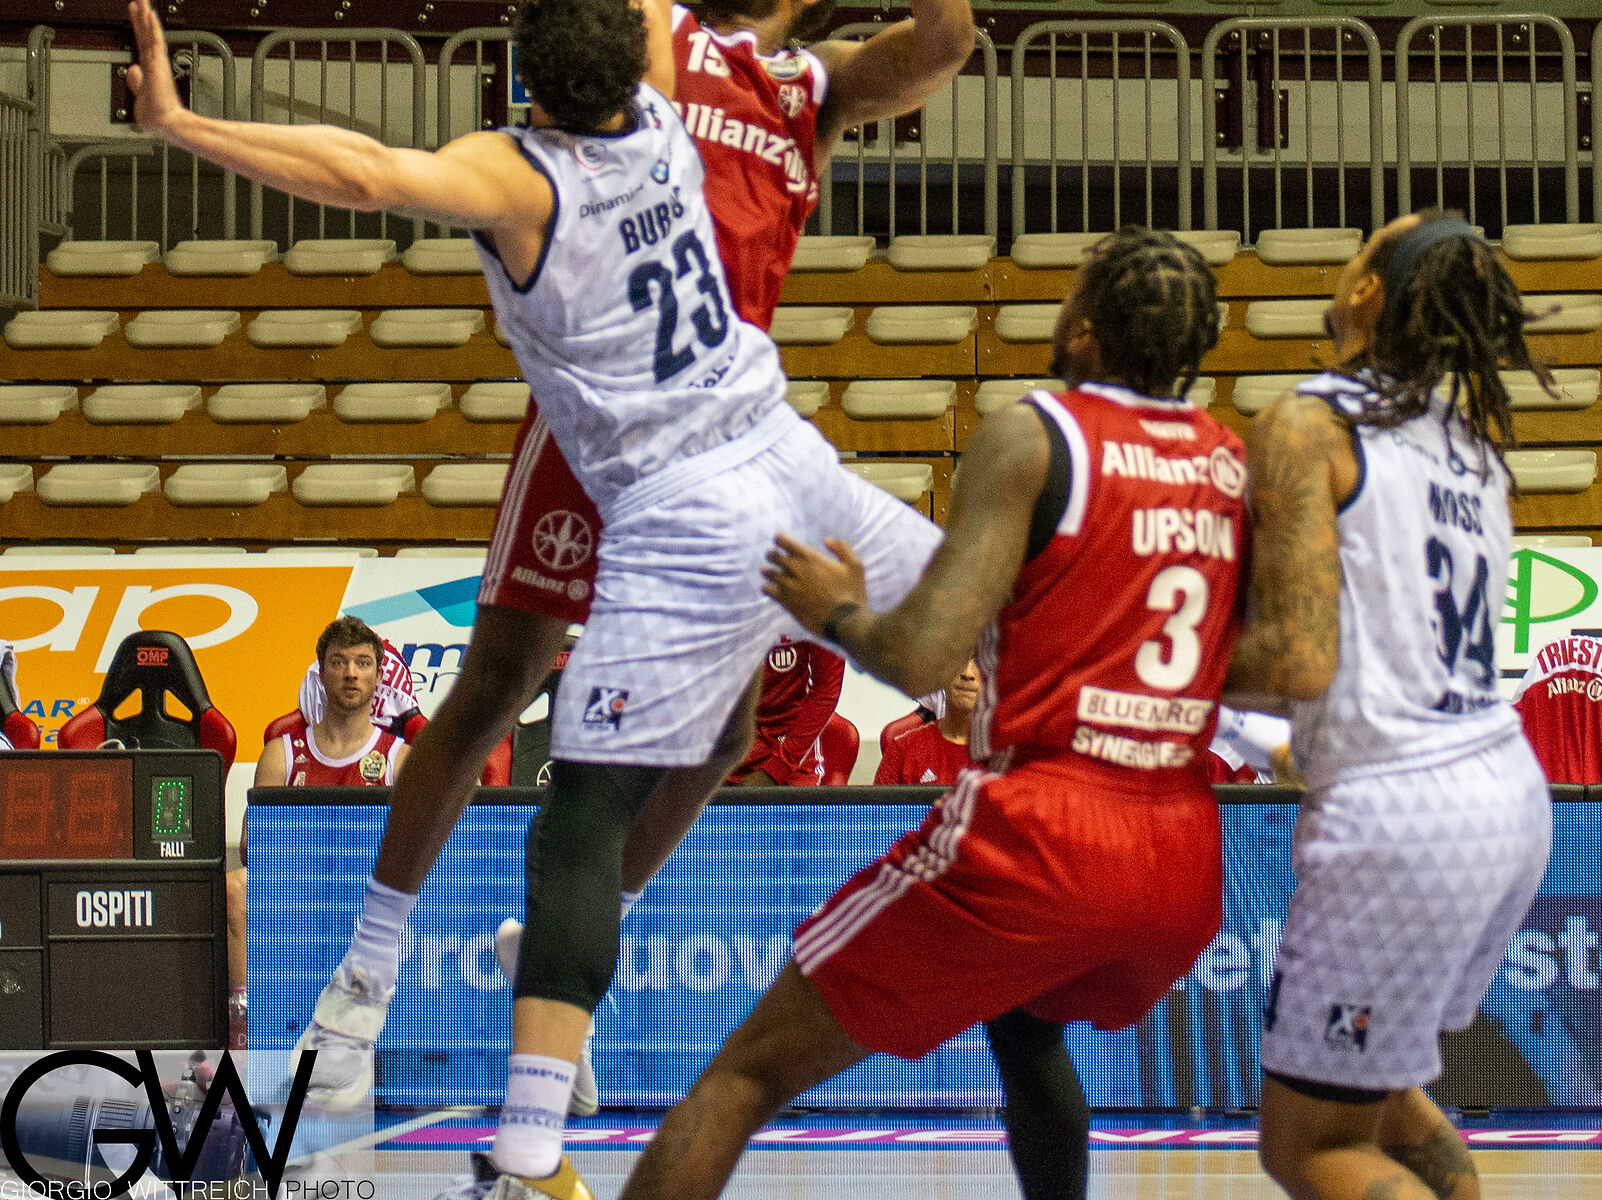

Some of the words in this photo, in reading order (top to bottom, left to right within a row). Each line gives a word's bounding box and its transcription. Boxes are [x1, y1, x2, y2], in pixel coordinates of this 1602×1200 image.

[686, 31, 731, 79] 15
[671, 101, 788, 167] llianz
[627, 229, 729, 385] 23
[1102, 440, 1210, 486] Allianz
[1132, 507, 1235, 561] UPSON
[1134, 564, 1210, 691] 3
[1424, 536, 1496, 692] 34
[137, 648, 168, 666] OMP
[155, 782, 185, 832] 0
[160, 841, 184, 857] FALLI
[76, 891, 152, 927] OSPITI
